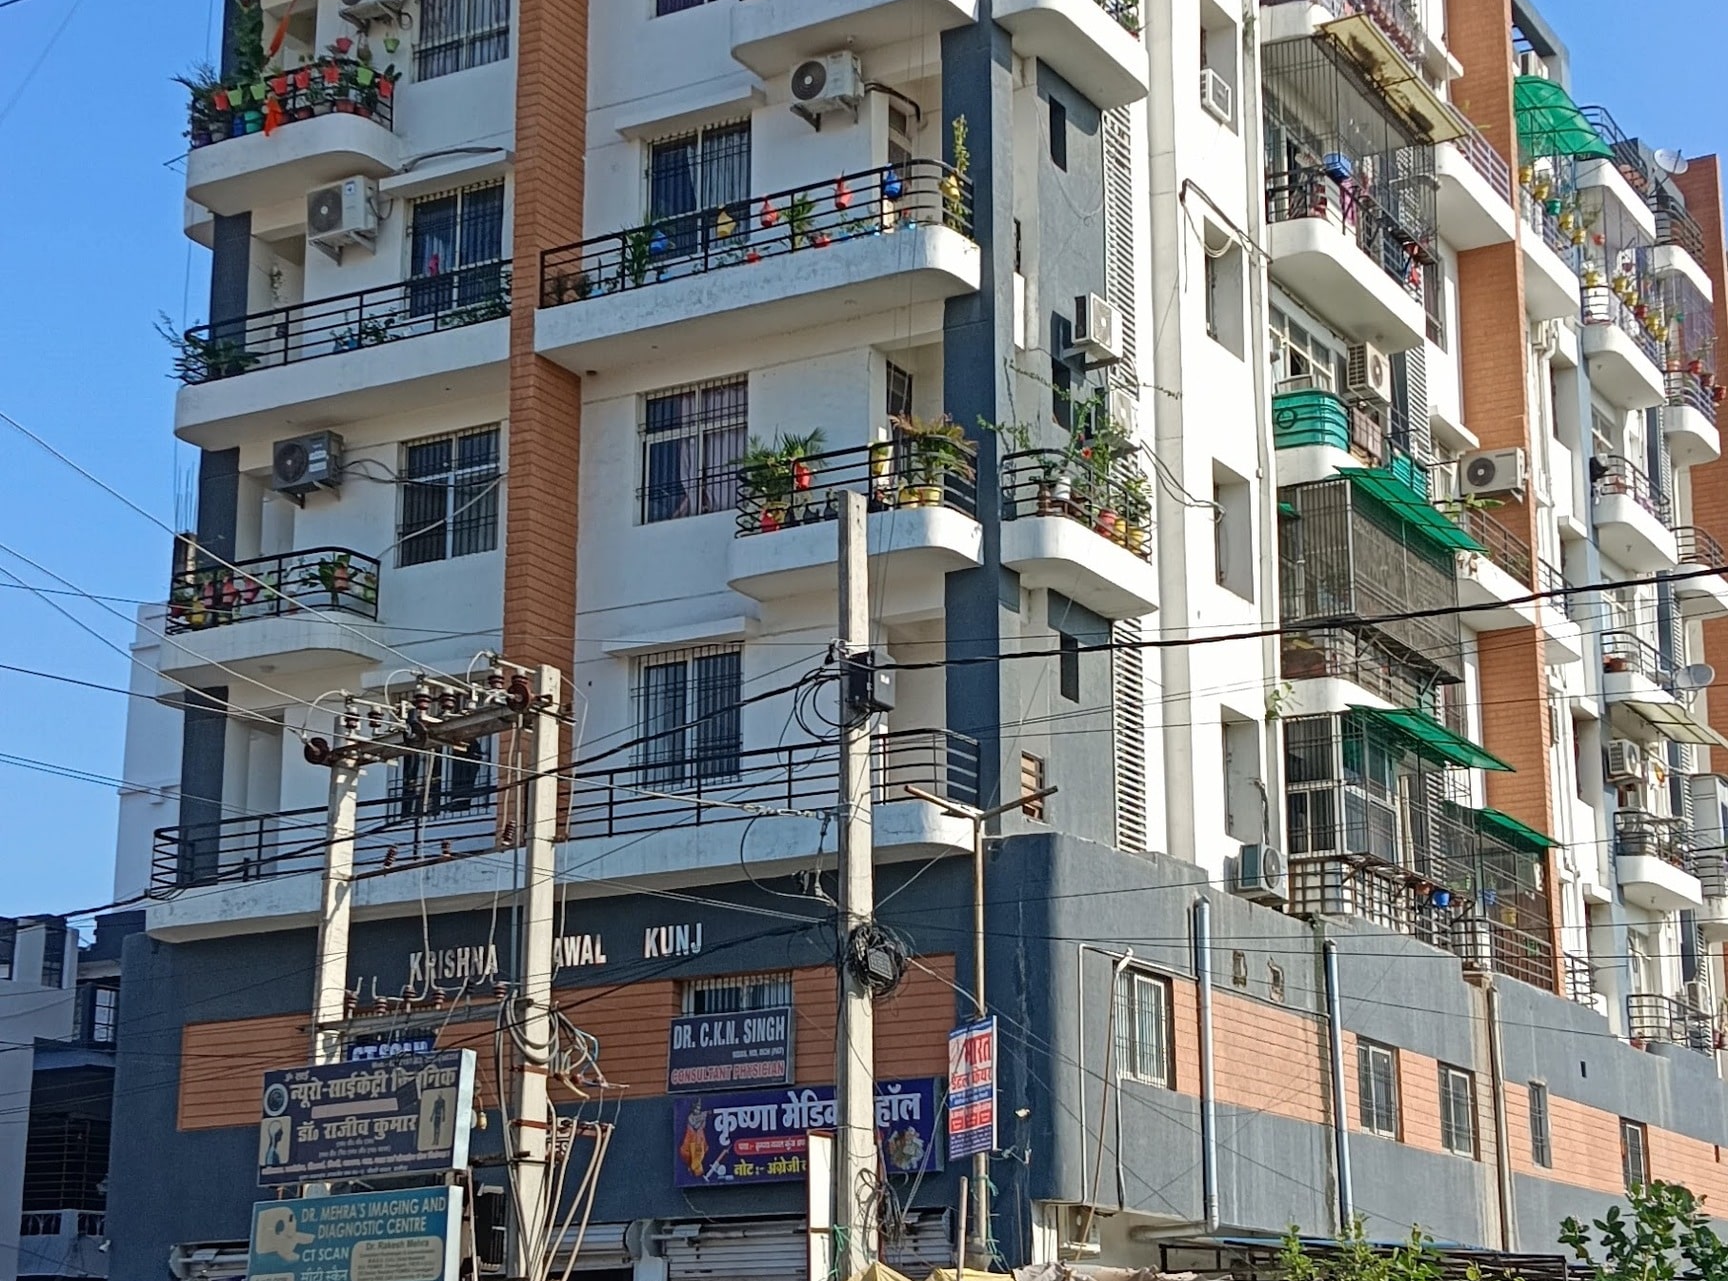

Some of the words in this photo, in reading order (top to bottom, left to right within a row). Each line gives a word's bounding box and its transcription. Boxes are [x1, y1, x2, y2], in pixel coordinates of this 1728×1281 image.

[409, 943, 498, 981] KRISHNA
[552, 934, 606, 968] AWAL
[644, 923, 702, 958] KUNJ
[673, 1025, 696, 1049] DR.
[700, 1020, 739, 1047] C.K.N.
[743, 1015, 785, 1044] SINGH
[671, 1065, 732, 1085] CONSULTANT
[733, 1060, 784, 1080] PHYSICIAN
[713, 1104, 777, 1145] कृष्णा
[782, 1090, 838, 1129] मेडिक
[875, 1084, 921, 1128] हॉल
[323, 1116, 370, 1139] राजीव
[373, 1115, 418, 1140] कुमार
[301, 1208, 317, 1222] DR.
[321, 1203, 365, 1221] MEHRA'S
[368, 1199, 418, 1216] IMAGING
[421, 1197, 445, 1213] AND
[318, 1220, 383, 1239] DIAGNOSTIC
[386, 1216, 426, 1234] CENTRE
[302, 1249, 317, 1262] CT
[319, 1247, 350, 1261] SCAN
[325, 1266, 349, 1281] स्कैन
